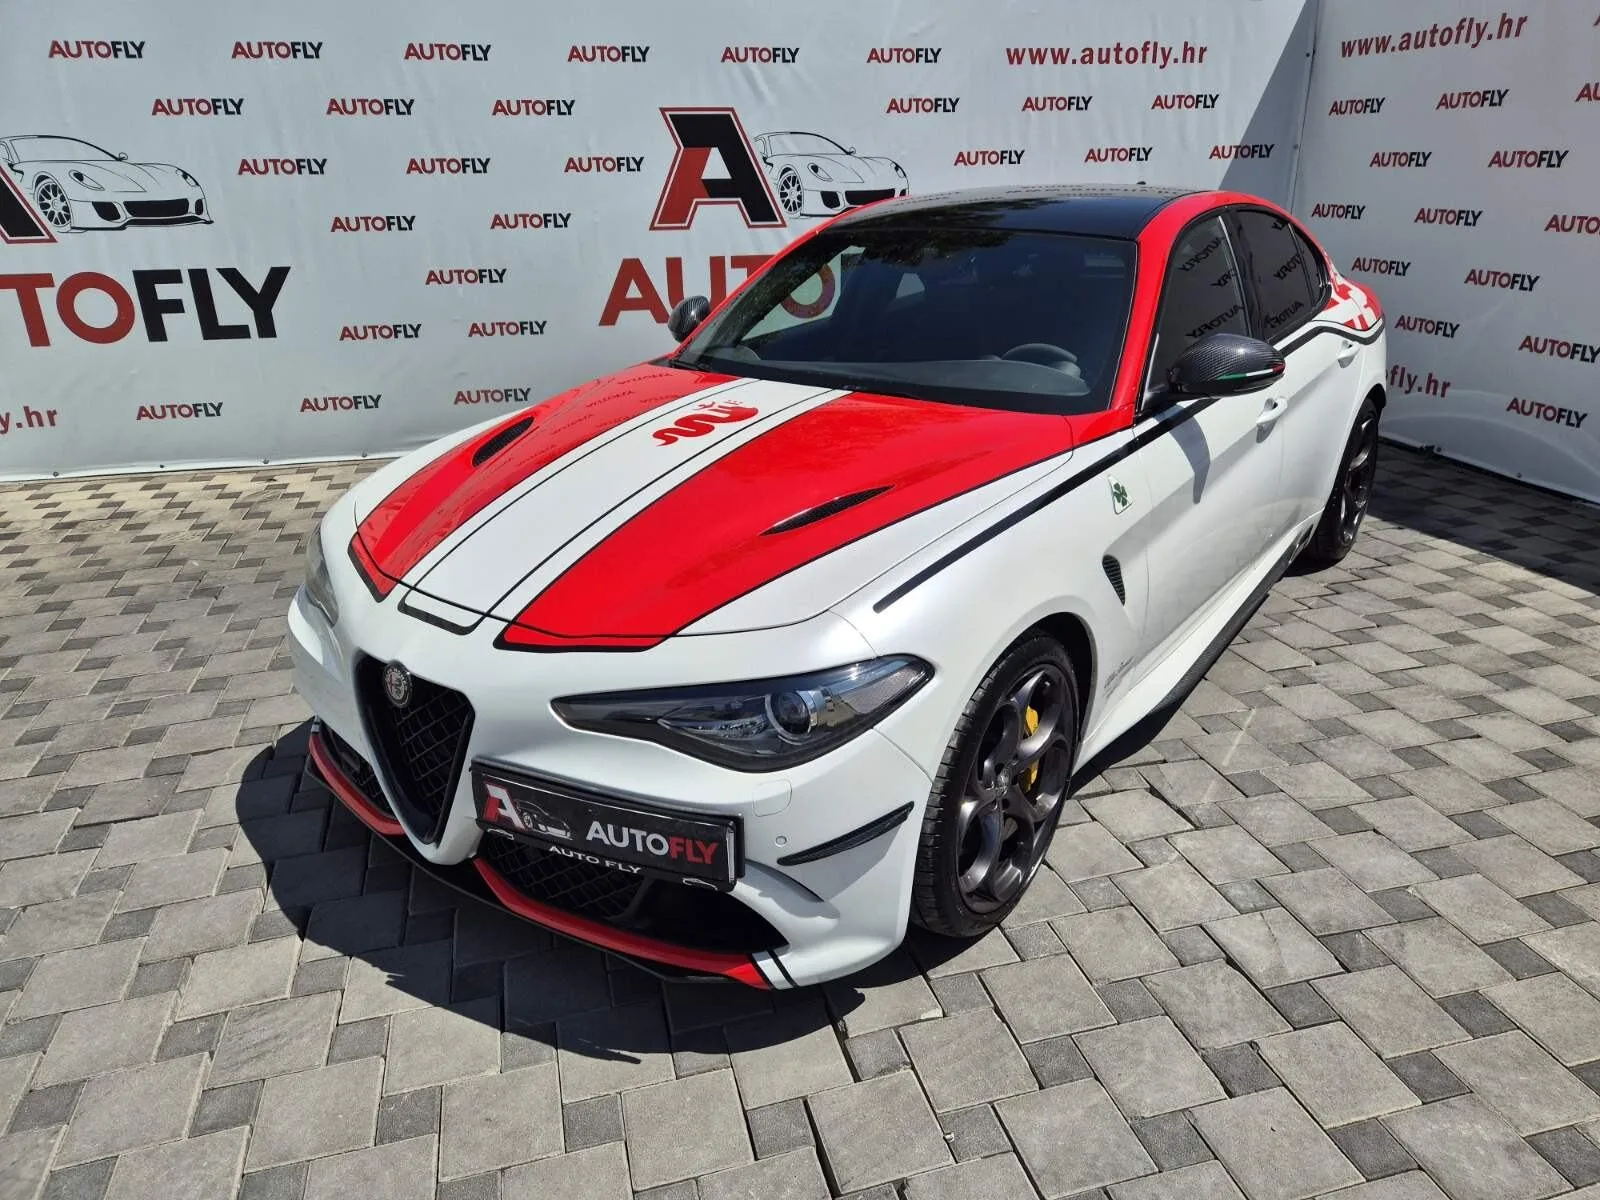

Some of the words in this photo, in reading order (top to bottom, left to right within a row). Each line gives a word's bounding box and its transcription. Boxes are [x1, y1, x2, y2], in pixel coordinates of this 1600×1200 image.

[1341, 12, 1529, 59] www.autofly.hr
[48, 40, 146, 59] AUTOFLY
[231, 41, 323, 60] AUTOFLY
[404, 42, 492, 62] AUTOFLY
[567, 45, 651, 63] AUTOFLY
[720, 46, 800, 64] AUTOFLY
[866, 47, 943, 64] AUTOFLY
[1005, 40, 1208, 70] www.autofly.hr
[151, 97, 245, 116] AUTOFLY
[326, 98, 415, 116] AUTOFLY
[491, 99, 576, 116] AUTOFLY
[885, 97, 960, 114] AUTOFLY
[1021, 95, 1093, 112] AUTOFLY
[1150, 93, 1220, 110] AUTOFLY
[1328, 96, 1386, 117] AUTOFLY
[1435, 88, 1510, 110] AUTOFLY
[953, 149, 1026, 167] AUTOFLY
[1084, 146, 1153, 163] AUTOFLY
[1209, 143, 1276, 160] AUTOFLY
[1369, 151, 1433, 168] AUTOFLY
[1487, 149, 1570, 169] AUTOFLY
[237, 158, 328, 176] AUTOFLY
[406, 157, 491, 175] AUTOFLY
[563, 156, 645, 173] AUTOFLY
[490, 212, 572, 230] AUTOFLY
[1311, 203, 1366, 220] AUTOFLY
[1413, 207, 1484, 227] AUTOFLY
[330, 215, 416, 233] AUTOFLY
[1351, 257, 1412, 277] AUTOFLY
[425, 268, 507, 286] AUTOFLY
[1463, 268, 1541, 292] AUTOFLY
[0, 265, 292, 348] TOFLY
[339, 323, 422, 342] AUTOFLY
[468, 320, 548, 338] AUTOFLY
[1394, 314, 1461, 339] AUTOFLY
[1518, 335, 1600, 364] AUTOFLY
[1386, 364, 1451, 398] fly.hr
[299, 394, 382, 413] AUTOFLY
[453, 387, 532, 405] AUTOFLY
[135, 401, 224, 421] AUTOFLY
[1505, 397, 1589, 429] AUTOFLY
[586, 820, 718, 865] AUTOFLY
[549, 844, 600, 865] AUTO
[604, 859, 642, 874] FLY
